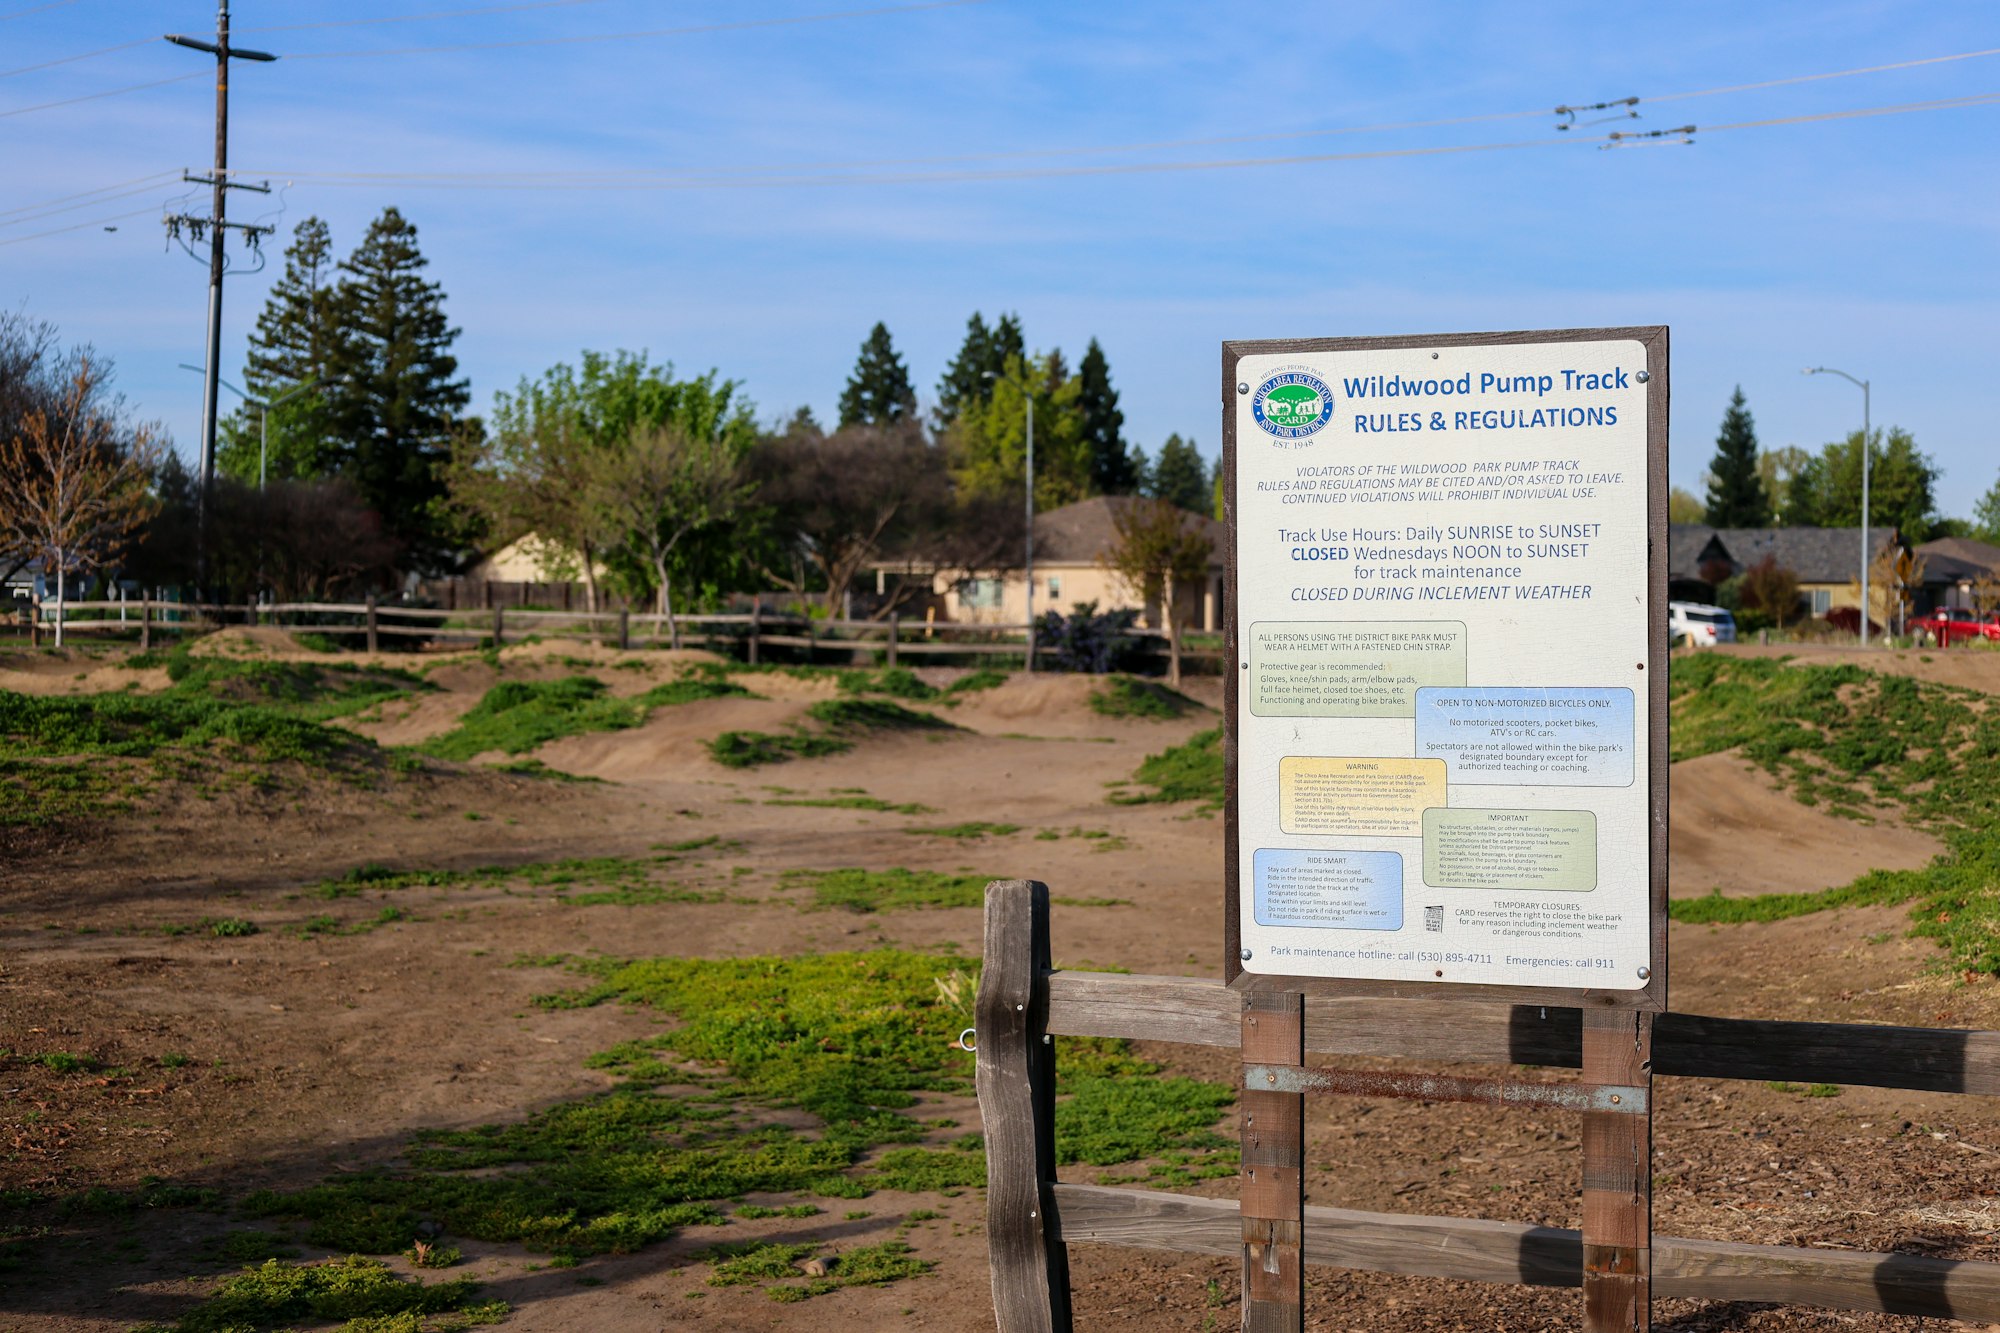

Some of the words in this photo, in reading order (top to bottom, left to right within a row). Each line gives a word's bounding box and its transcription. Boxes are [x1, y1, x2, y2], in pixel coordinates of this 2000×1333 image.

[1261, 366, 1285, 380] HELPING
[1311, 367, 1325, 377] PLAY
[1343, 373, 1470, 397] Wildwood
[1481, 373, 1552, 396] Pump
[1560, 367, 1628, 390] Track
[1254, 382, 1272, 406] CHICO
[1273, 375, 1292, 387] AREA
[1294, 375, 1332, 403] RECREATION
[1259, 419, 1275, 434] AND
[1276, 427, 1293, 436] PARK
[1296, 416, 1326, 436] DISTRICT
[1355, 413, 1422, 432] RULES
[1429, 411, 1447, 431] &
[1455, 407, 1617, 429] REGULATIONS
[1273, 440, 1289, 449] EST.
[1295, 439, 1313, 449] 1948
[1296, 465, 1355, 476] VIOLATORS
[1357, 465, 1373, 476] OF
[1376, 464, 1397, 475] THE
[1400, 463, 1467, 474] WILDWOOD
[1472, 462, 1502, 472] PARK
[1504, 460, 1539, 472] PUMP
[1542, 460, 1580, 470] TRACK
[1257, 480, 1290, 491] RULES
[1291, 480, 1317, 490] AND
[1319, 478, 1395, 490] REGULATIONS
[1397, 477, 1424, 488] MAY
[1425, 477, 1440, 488] BE
[1442, 476, 1474, 487] CITED
[1476, 474, 1525, 487] AND/OR
[1526, 474, 1564, 485] ASKED
[1568, 473, 1583, 484] TO
[1586, 472, 1624, 483] LEAVE.
[1282, 492, 1347, 504] CONTINUED
[1350, 491, 1415, 502] VIOLATIONS
[1418, 491, 1444, 501] WILL
[1447, 489, 1501, 500] PROHIBIT
[1502, 488, 1568, 499] INDIVIDUAL
[1572, 487, 1596, 498] USE.
[1278, 528, 1316, 542] Track
[1321, 528, 1348, 541] Use
[1353, 528, 1400, 541] Hours:
[1406, 526, 1443, 543] Daily
[1447, 525, 1513, 539] SUNRISE
[1518, 526, 1534, 538] to
[1539, 523, 1601, 538] SUNSET
[1291, 547, 1349, 560] CLOSED
[1353, 546, 1448, 561] Wednesdays
[1453, 545, 1501, 558] NOON
[1506, 546, 1522, 558] to
[1527, 543, 1589, 558] SUNSET
[1354, 564, 1375, 579] for
[1379, 564, 1417, 578] track
[1422, 565, 1521, 578] maintenance
[1291, 587, 1348, 601] CLOSED
[1352, 586, 1414, 600] DURING
[1418, 586, 1511, 600] INCLEMENT
[1515, 585, 1591, 599] WEATHER
[1260, 675, 1288, 684] Gloves,
[1290, 675, 1328, 684] knee/shin
[1329, 675, 1349, 685] pads,
[1352, 675, 1394, 684] arm/elbow
[1396, 675, 1418, 685] pads,
[1292, 685, 1321, 694] helmet,
[1365, 685, 1389, 695] shoes,
[1260, 696, 1304, 706] Functioning
[1322, 696, 1360, 706] operating
[1506, 720, 1542, 728] scooters,
[1545, 719, 1572, 729] pocket
[1574, 719, 1598, 728] bikes,
[1426, 742, 1468, 752] Spectators
[1598, 744, 1623, 754] park's
[1459, 752, 1503, 762] designated
[1505, 752, 1544, 762] boundary
[1546, 754, 1573, 763] except
[1458, 762, 1501, 770] authorized
[1503, 763, 1538, 772] teaching
[1551, 763, 1590, 773] coaching.
[1494, 901, 1540, 909] TEMPORARY
[1541, 902, 1582, 910] CLOSURES:
[1270, 945, 1291, 955] Park
[1293, 947, 1355, 958] maintenance
[1358, 949, 1395, 959] hotline:
[1398, 951, 1414, 960] call
[1417, 951, 1443, 963] (530)
[1445, 952, 1492, 963] 895-4711
[1506, 955, 1572, 967] Emergencies:
[1575, 958, 1592, 967] call
[1595, 958, 1614, 968] 911
